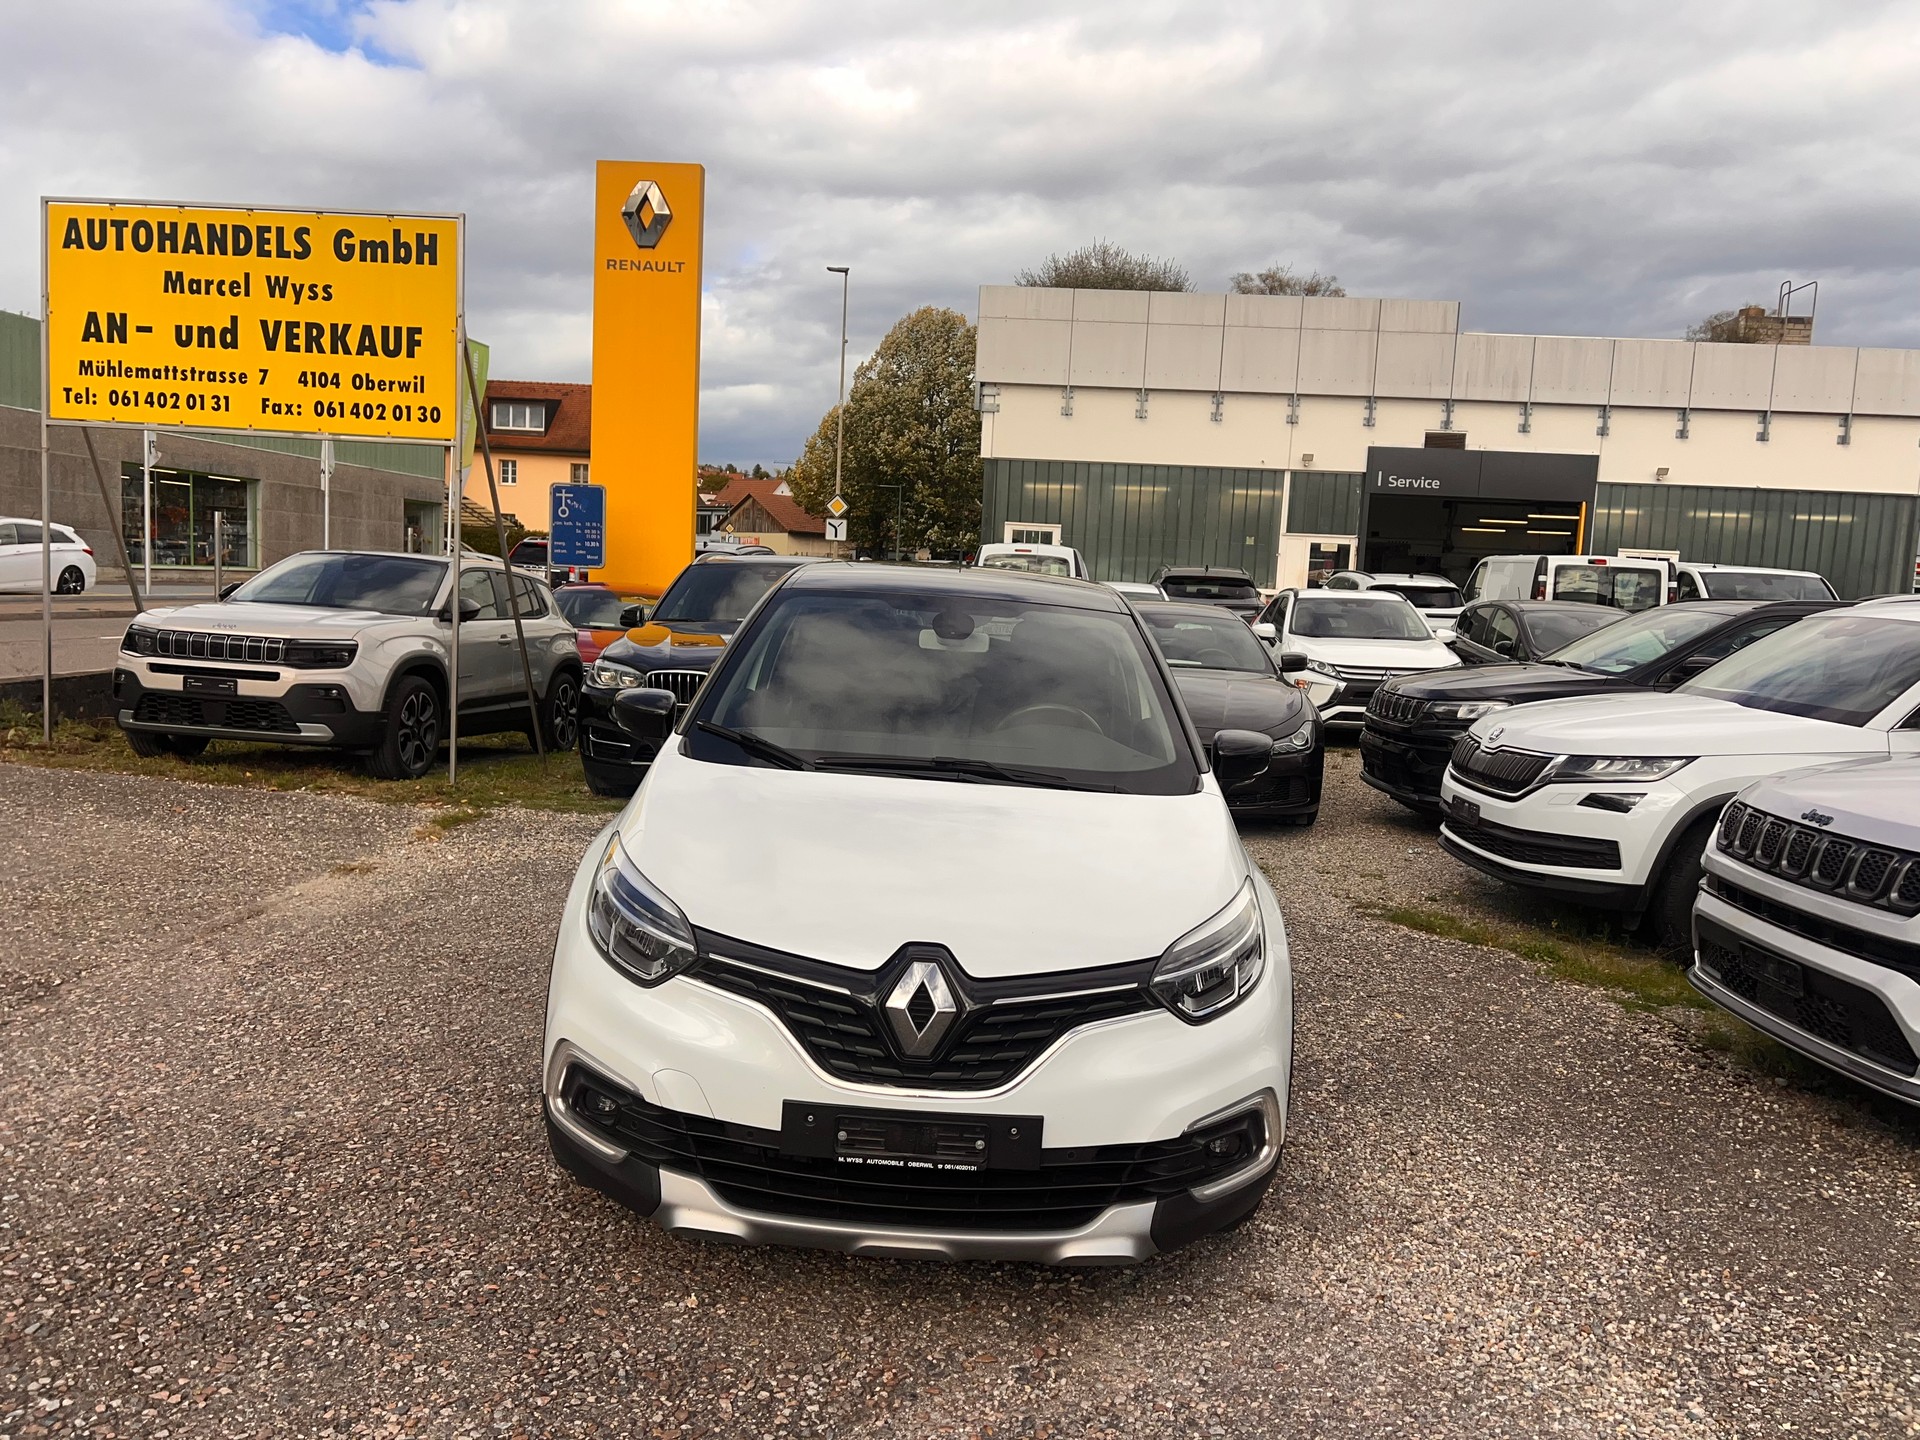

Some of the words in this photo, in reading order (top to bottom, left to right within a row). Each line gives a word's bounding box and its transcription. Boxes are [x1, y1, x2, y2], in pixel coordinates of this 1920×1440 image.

[62, 217, 312, 261] AUTOHANDELS
[333, 228, 438, 266] GmbH
[606, 258, 685, 273] RENAULT
[163, 270, 251, 298] Marcel
[265, 275, 333, 305] Wyss
[174, 315, 239, 350] und
[259, 319, 423, 359] VERKAUF
[78, 359, 248, 385] Mühlemattstrasse
[258, 368, 269, 386] 7
[297, 370, 341, 389] 4104
[351, 373, 425, 394] Oberwil
[62, 386, 97, 406] Tel:
[261, 397, 302, 417] Fax:
[1388, 475, 1440, 489] Service
[1801, 808, 1834, 827] Jeep
[866, 1158, 904, 1167] AUTOMOBILE
[907, 1161, 934, 1169] OBERWIL
